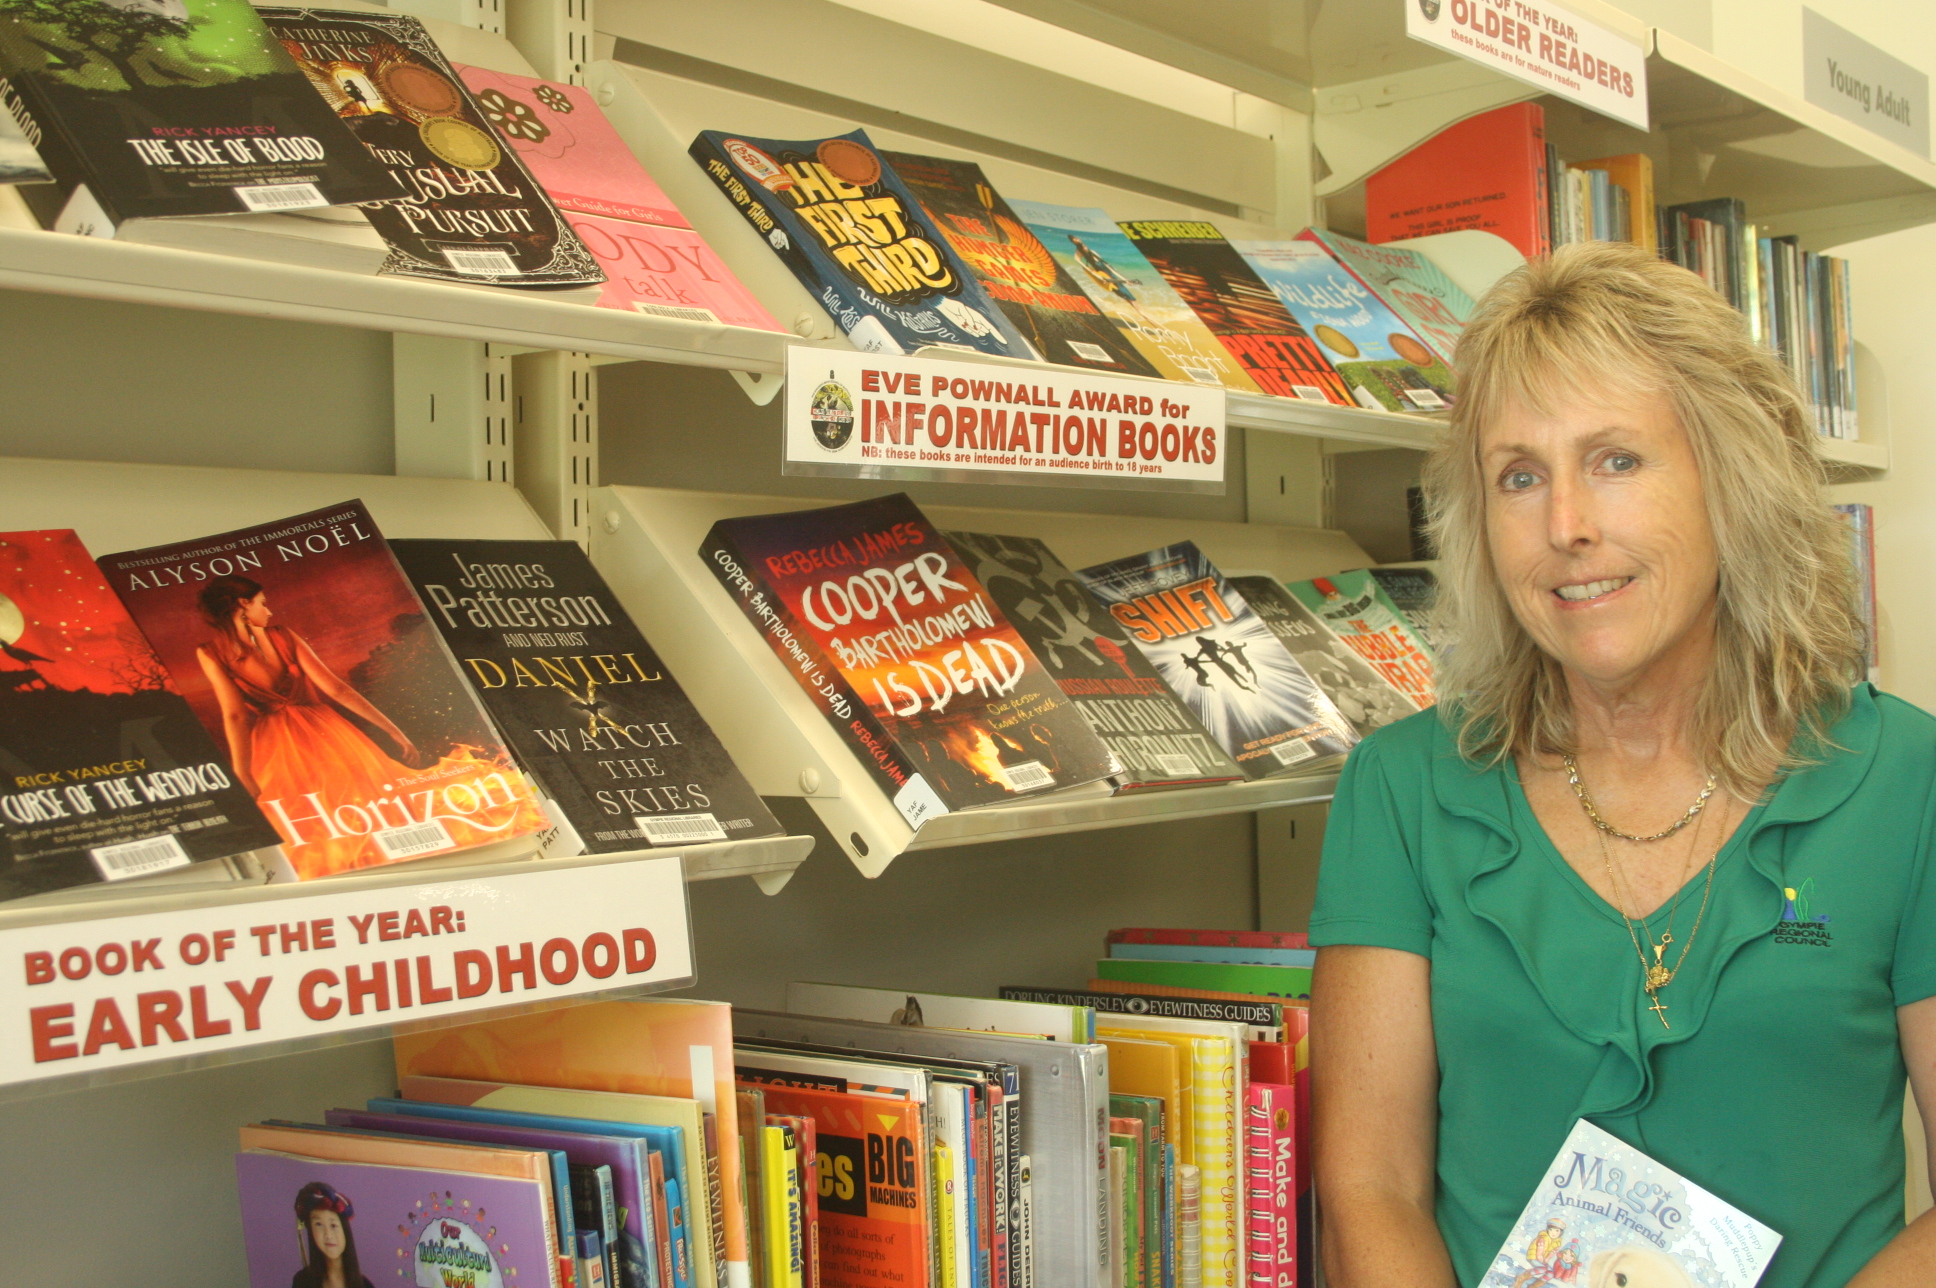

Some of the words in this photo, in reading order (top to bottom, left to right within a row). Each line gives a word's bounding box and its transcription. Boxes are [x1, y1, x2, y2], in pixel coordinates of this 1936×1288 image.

[269, 26, 375, 44] CATHERINE
[1516, 4, 1540, 26] THE
[1542, 14, 1578, 44] YEAR:
[300, 42, 374, 64] JINKS
[1450, 0, 1532, 54] OLDER
[1539, 32, 1634, 98] READERS
[1451, 28, 1473, 47] these
[1475, 38, 1499, 57] books
[1501, 50, 1513, 63] are
[1515, 55, 1526, 68] for
[1527, 61, 1552, 79] mature
[1554, 73, 1581, 91] readers
[1827, 57, 1871, 113] Young
[1876, 84, 1911, 127] Adult
[126, 139, 182, 166] THE
[174, 139, 230, 165] ISLE
[223, 138, 256, 164] OF
[253, 136, 324, 162] BLOOD
[151, 126, 198, 137] RICK
[200, 126, 277, 136] YANCEY
[574, 198, 610, 214] Guide
[612, 204, 630, 217] for
[632, 208, 664, 222] Girls
[708, 159, 726, 182] THE
[724, 174, 752, 206] FIRST
[747, 202, 774, 233] THIRD
[394, 203, 535, 238] PURSUIT
[794, 197, 906, 249] FIRST
[944, 213, 993, 238] THE
[1134, 222, 1224, 240] SCHREIBER
[1456, 214, 1482, 223] PROOF
[832, 237, 952, 296] THIRD
[948, 233, 1034, 264] HUNGER
[622, 274, 698, 304] talk
[974, 258, 1051, 288] GAMES
[1158, 345, 1230, 380] Bright
[1215, 334, 1337, 373] PRETTY
[860, 369, 922, 396] EVE
[932, 376, 1060, 408] POWNALL
[1068, 388, 1154, 416] AWARD
[1160, 396, 1190, 420] for
[860, 398, 1107, 458] INFORMATION
[1118, 419, 1217, 465] BOOKS
[861, 446, 882, 458] NB:
[886, 446, 916, 460] these
[920, 449, 952, 463] books
[954, 454, 971, 464] are
[974, 451, 1017, 466] intended
[1019, 453, 1034, 466] for
[1035, 456, 1046, 468] an
[1048, 455, 1090, 470] audience
[1092, 457, 1112, 471] birth
[1114, 459, 1125, 472] to
[1127, 460, 1137, 473] 18
[1139, 463, 1162, 476] years
[117, 554, 180, 570] BESTSELLING
[182, 544, 223, 559] AUTHOR
[224, 540, 238, 552] OF
[238, 534, 262, 548] THE
[263, 518, 326, 542] IMMORTALS
[326, 510, 358, 525] SERIES
[130, 551, 262, 591] ALYSON
[276, 522, 371, 562] NOËL
[765, 542, 852, 580] REBECCA
[852, 522, 925, 569] JAMES
[452, 552, 556, 590] James
[424, 584, 612, 630] Patterson
[802, 551, 968, 633] COOPER
[1110, 576, 1234, 643] SHIFT
[502, 633, 532, 648] AND
[530, 632, 559, 648] NED
[554, 632, 590, 647] RUST
[831, 593, 995, 670] BARTHOLOMEW
[464, 652, 662, 688] DANIEL
[714, 549, 754, 597] COOPER
[750, 592, 817, 674] BARTHOLOMEW
[810, 670, 826, 687] IS
[820, 683, 852, 720] DEAD
[850, 720, 889, 763] REBECCA
[872, 672, 925, 718] IS
[910, 638, 1025, 714] DEAD
[1105, 678, 1167, 696] ROULETTE
[986, 703, 1010, 715] One
[1010, 692, 1040, 712] person
[988, 716, 1018, 731] knows
[1017, 709, 1034, 721] the
[1074, 698, 1192, 732] ANTHONY
[534, 721, 682, 754] WATCH
[1100, 733, 1226, 771] HOROWITZ
[14, 770, 65, 788] RICK
[67, 758, 148, 778] YANCEY
[396, 776, 416, 788] The
[418, 772, 437, 784] Soul
[438, 764, 476, 780] Seekers
[598, 757, 665, 780] THE
[2, 787, 71, 824] CURSE
[66, 784, 96, 815] OF
[94, 777, 142, 810] THE
[135, 762, 232, 803] WENDIGO
[264, 771, 523, 848] Horizon
[596, 783, 712, 816] SKIES
[912, 802, 928, 821] JAME
[594, 831, 618, 842] FROM
[725, 818, 754, 830] WRITER
[24, 936, 164, 986] BOOK
[178, 928, 236, 966] OF
[250, 918, 337, 958] THE
[346, 904, 468, 945] YEAR:
[1770, 929, 1834, 940] REGIONAL
[1774, 936, 1832, 948] COUNCIL
[29, 976, 275, 1064] EARLY
[298, 926, 658, 1022] CHILDHOOD
[1057, 994, 1127, 1012] KINDERSLEY
[1150, 999, 1224, 1018] EYEWITNESS
[1225, 1004, 1271, 1022] GUIDES
[992, 1104, 1004, 1156] MAKE
[1222, 1064, 1236, 1168] Children's
[1010, 1106, 1020, 1197] EYEWITNESS
[1097, 1106, 1106, 1170] MOON
[868, 1132, 916, 1188] BIG
[1275, 1136, 1292, 1208] Make
[787, 1168, 796, 1196] IT'S
[870, 1186, 916, 1209] MACHINES
[995, 1166, 1006, 1234] WORK!
[1553, 1151, 1682, 1230] Magic
[707, 1156, 728, 1280] EYEWITNESS
[980, 1182, 988, 1244] Machines
[1098, 1176, 1108, 1266] LANDING
[1221, 1174, 1236, 1240] World
[1552, 1190, 1610, 1218] Animal
[1613, 1204, 1668, 1249] Friends
[788, 1202, 800, 1274] AMAZING!
[832, 1243, 886, 1262] photographs
[833, 1225, 845, 1238] do
[848, 1227, 859, 1240] all
[862, 1230, 882, 1244] sorts
[885, 1232, 895, 1246] of
[1276, 1216, 1293, 1265] and
[1709, 1217, 1733, 1248] Daring
[1731, 1246, 1748, 1279] Rescue
[1722, 1215, 1758, 1271] Muddlepup's
[1744, 1223, 1764, 1250] Poppy
[824, 1260, 840, 1270] can
[842, 1262, 860, 1275] find
[864, 1266, 877, 1278] out
[880, 1269, 904, 1283] what
[1012, 1232, 1020, 1287] GUIDES
